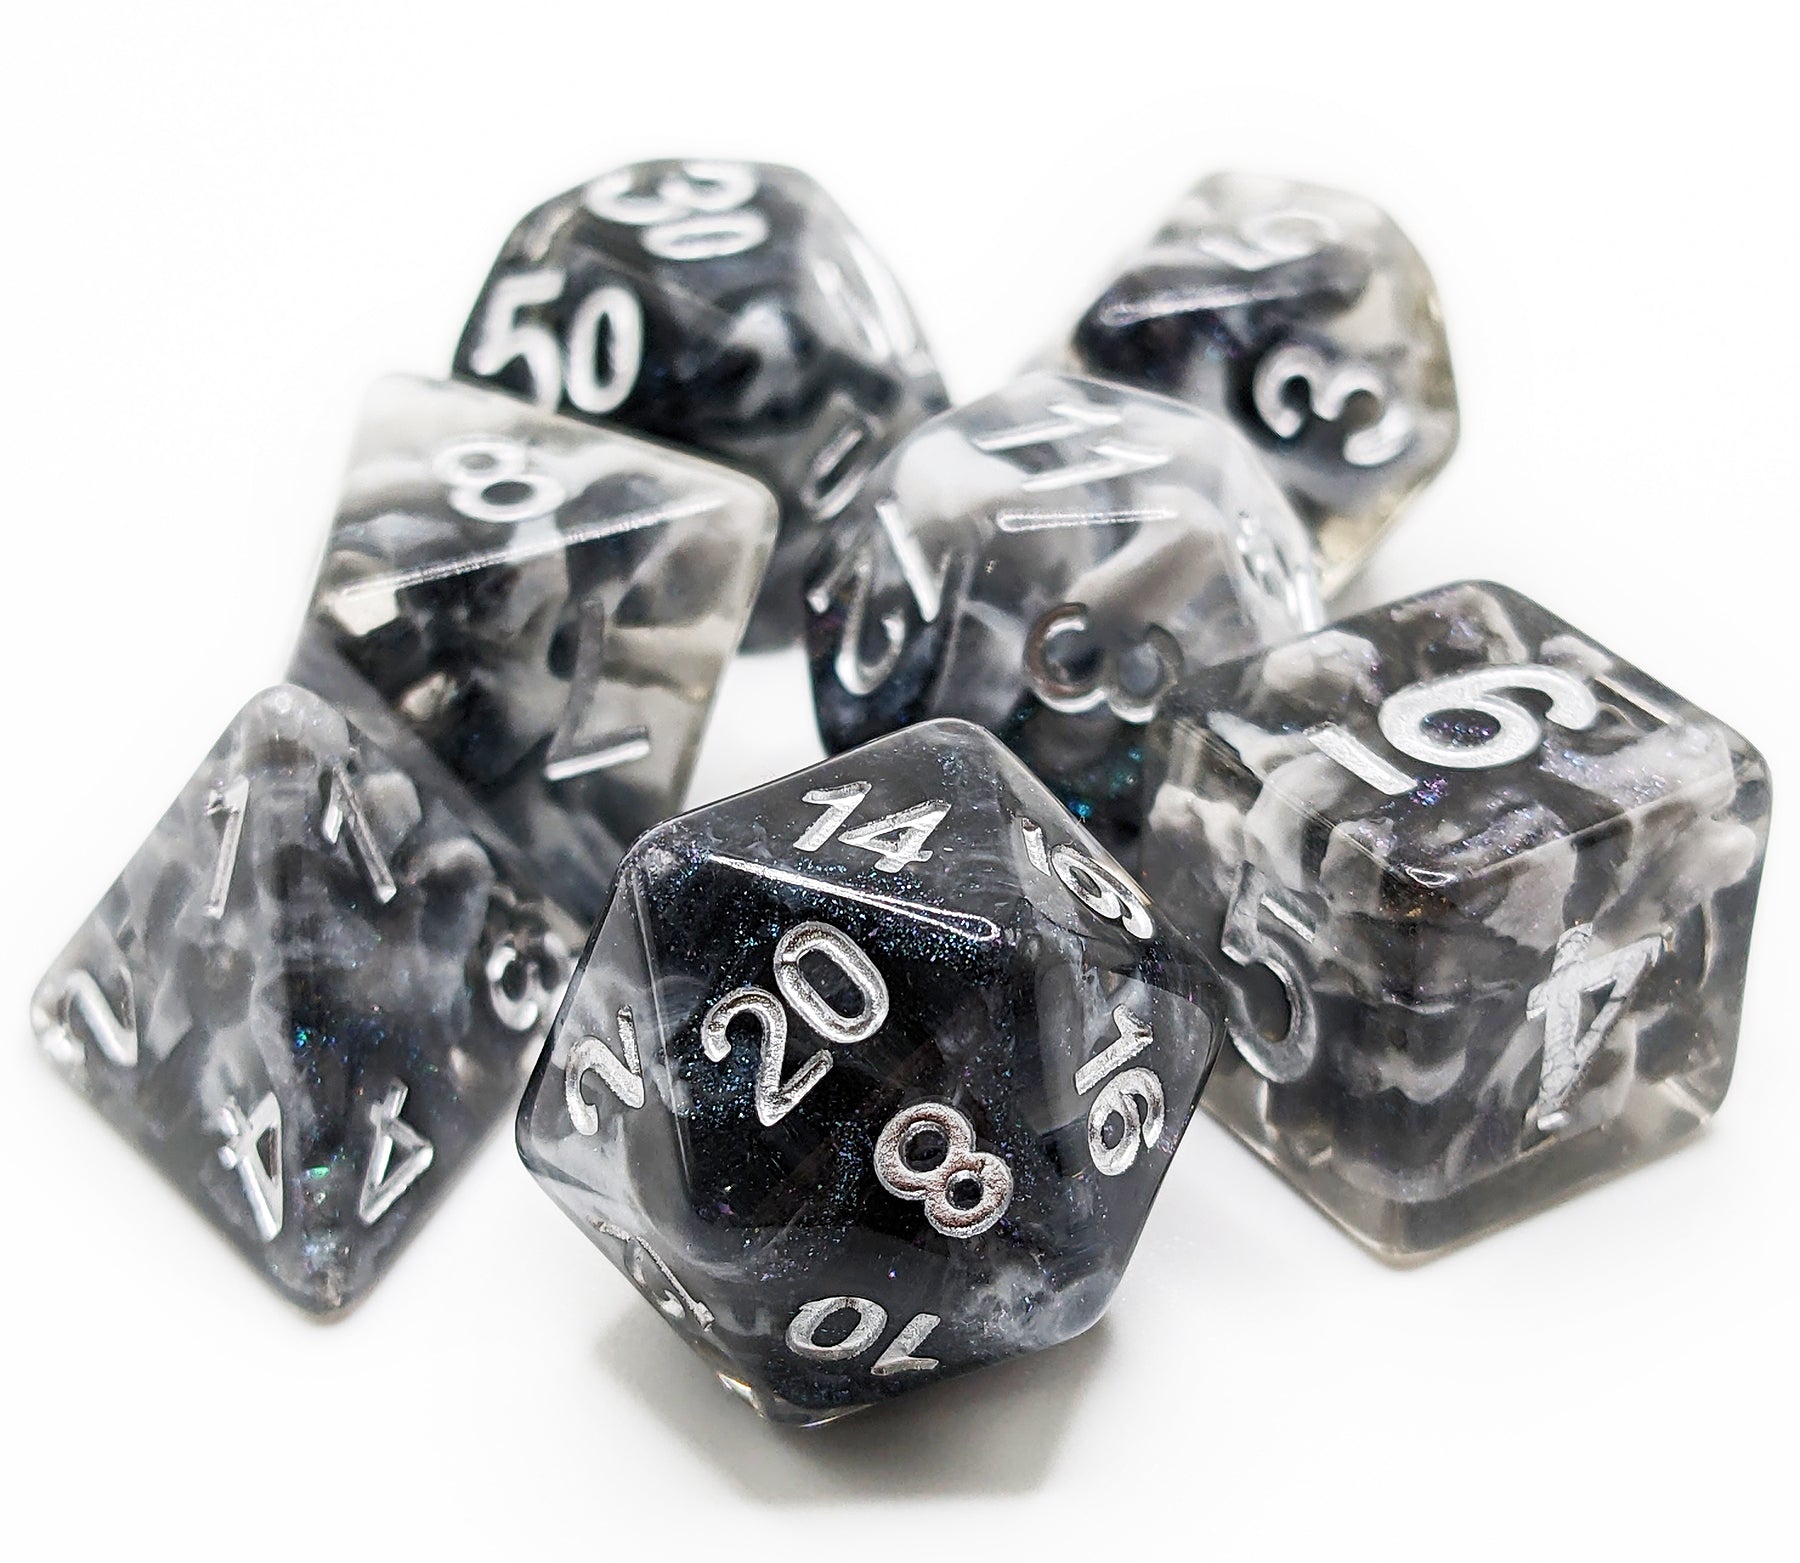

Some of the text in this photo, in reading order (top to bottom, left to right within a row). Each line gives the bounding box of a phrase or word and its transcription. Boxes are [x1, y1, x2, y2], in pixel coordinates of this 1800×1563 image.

[585, 160, 771, 260] 30
[469, 267, 643, 414] 50
[1253, 345, 1413, 467] 3
[433, 435, 566, 522] 8
[971, 401, 1172, 492] 11
[806, 499, 951, 696] 12
[546, 598, 652, 782] 7
[206, 776, 250, 919] 1
[322, 761, 398, 905] 1
[794, 781, 952, 874] 14
[32, 964, 139, 1068] 2
[701, 920, 890, 1128] 20
[1220, 861, 1318, 1085] 5
[1526, 922, 1674, 1132] 4
[565, 1005, 646, 1137] 2
[1074, 1004, 1167, 1178] 16
[218, 1090, 285, 1242] 4
[358, 1078, 435, 1225] 4
[873, 1101, 1014, 1239] 8
[785, 1296, 942, 1377] 10
